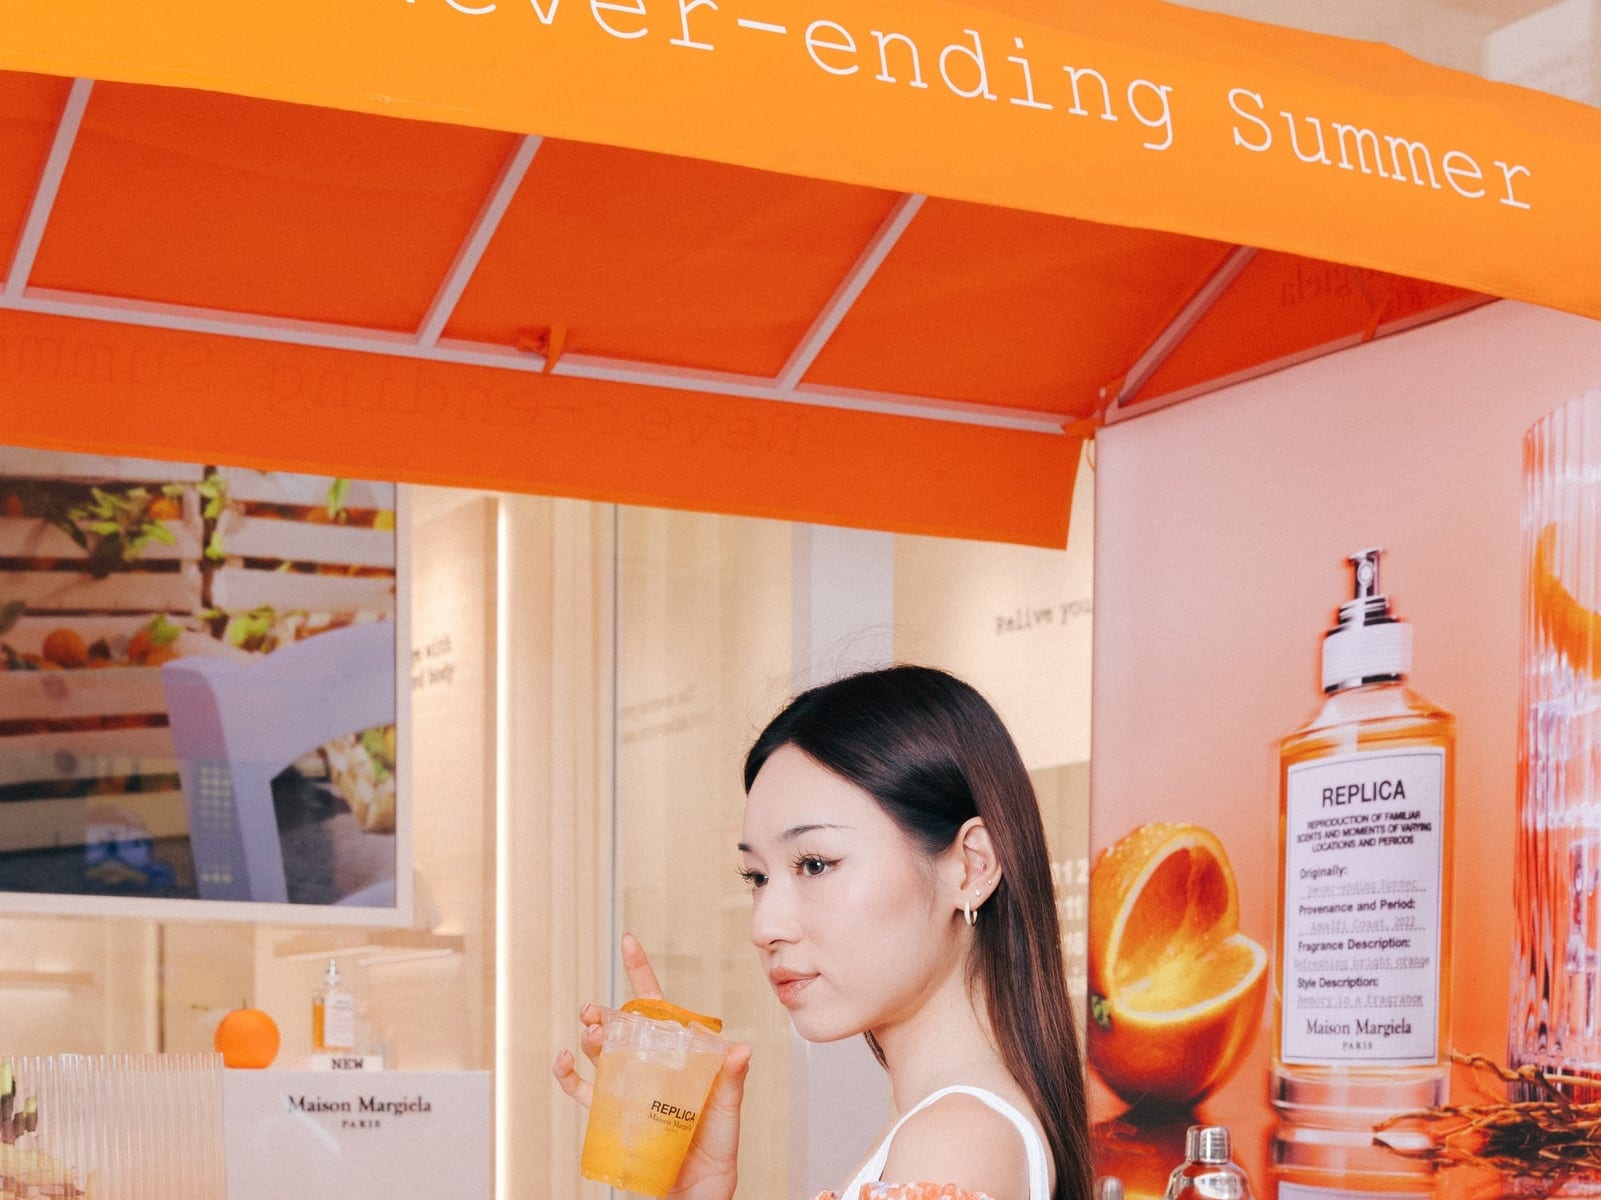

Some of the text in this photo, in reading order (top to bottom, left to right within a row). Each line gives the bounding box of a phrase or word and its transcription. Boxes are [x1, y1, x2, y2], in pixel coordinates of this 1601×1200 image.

[407, 0, 1531, 210] ver-ending Summer
[1322, 779, 1406, 808] REPLICA
[1307, 810, 1421, 830] REPRODUCTION OF FAMILIAR
[1324, 828, 1341, 839] AND
[1343, 824, 1385, 837] MOMENTS
[1387, 823, 1398, 833] OF
[1400, 822, 1432, 832] VARYING
[1312, 835, 1414, 853] LOCATIONS AND PERIODS
[1299, 864, 1347, 881] Originally:
[1299, 897, 1416, 915] Provenance and Period:
[1298, 937, 1411, 954] Fragrance Description:
[1297, 976, 1378, 990] Style Description:
[1306, 1017, 1412, 1038] Maison Margiela
[1342, 1041, 1373, 1051] PARIS
[332, 1058, 363, 1070] NEW
[288, 1095, 432, 1116] Maison Margiela
[651, 1100, 696, 1122] REPLICA
[341, 1120, 381, 1128] PARIS
